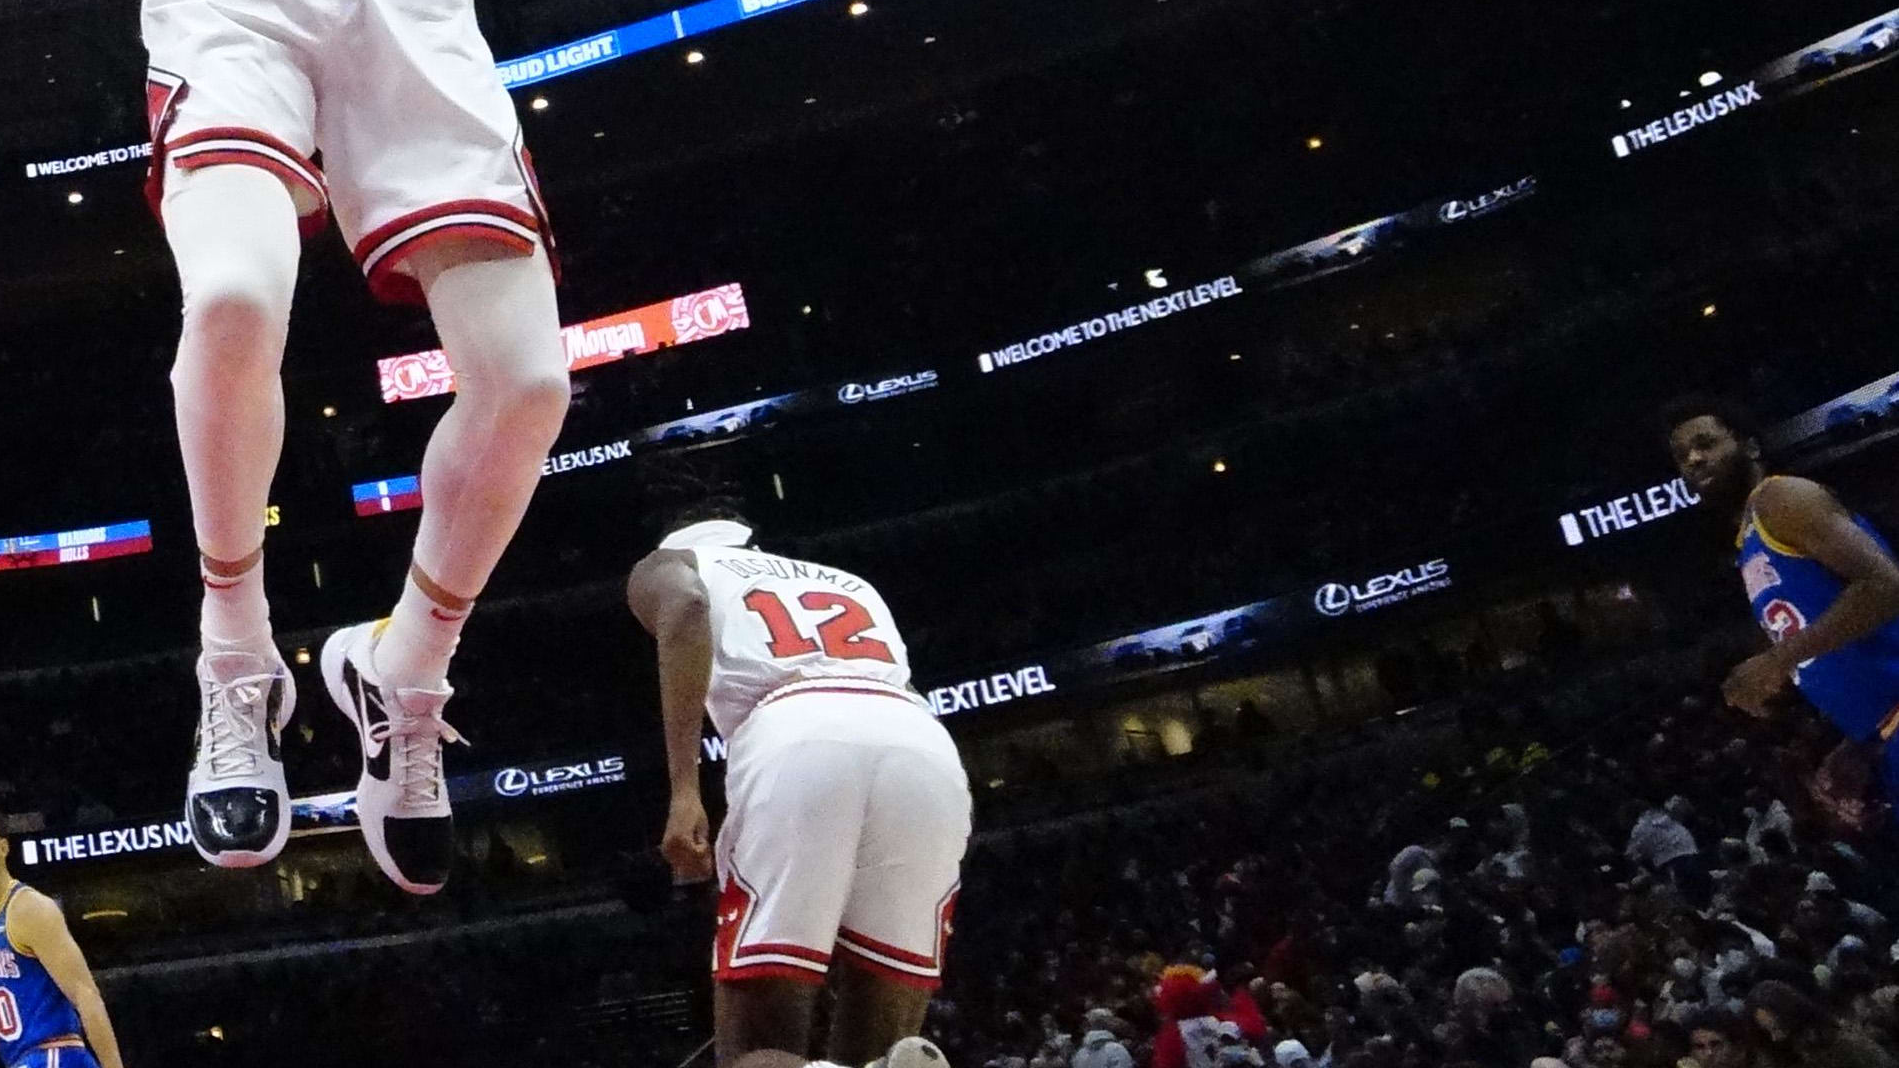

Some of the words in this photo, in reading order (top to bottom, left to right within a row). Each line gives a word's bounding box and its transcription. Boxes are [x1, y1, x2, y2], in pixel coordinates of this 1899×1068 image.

[500, 58, 544, 86] BUD
[548, 36, 614, 71] LIGHT
[1627, 120, 1667, 149] THE
[1664, 94, 1728, 137] LEXUS
[1725, 81, 1762, 111] NX
[38, 151, 109, 175] WELCOME
[109, 148, 128, 163] TO
[128, 142, 153, 159] THE
[993, 324, 1083, 366] WELCOME
[1081, 319, 1107, 340] TO
[1105, 306, 1141, 331] THE
[1139, 290, 1186, 322] NEXT
[1186, 276, 1243, 308] LEVEL
[564, 320, 646, 367] Morgan
[865, 371, 938, 394] LEXUS
[550, 444, 606, 474] LEXUS
[603, 440, 632, 460] NX
[1580, 496, 1638, 538] THE
[1350, 558, 1449, 601] LEXUS
[743, 589, 897, 664] 12
[927, 681, 979, 717] NEXT
[980, 666, 1057, 705] LEVEL
[530, 757, 625, 785] LEXUS
[41, 835, 88, 863] THE
[87, 824, 163, 858] LEXUS
